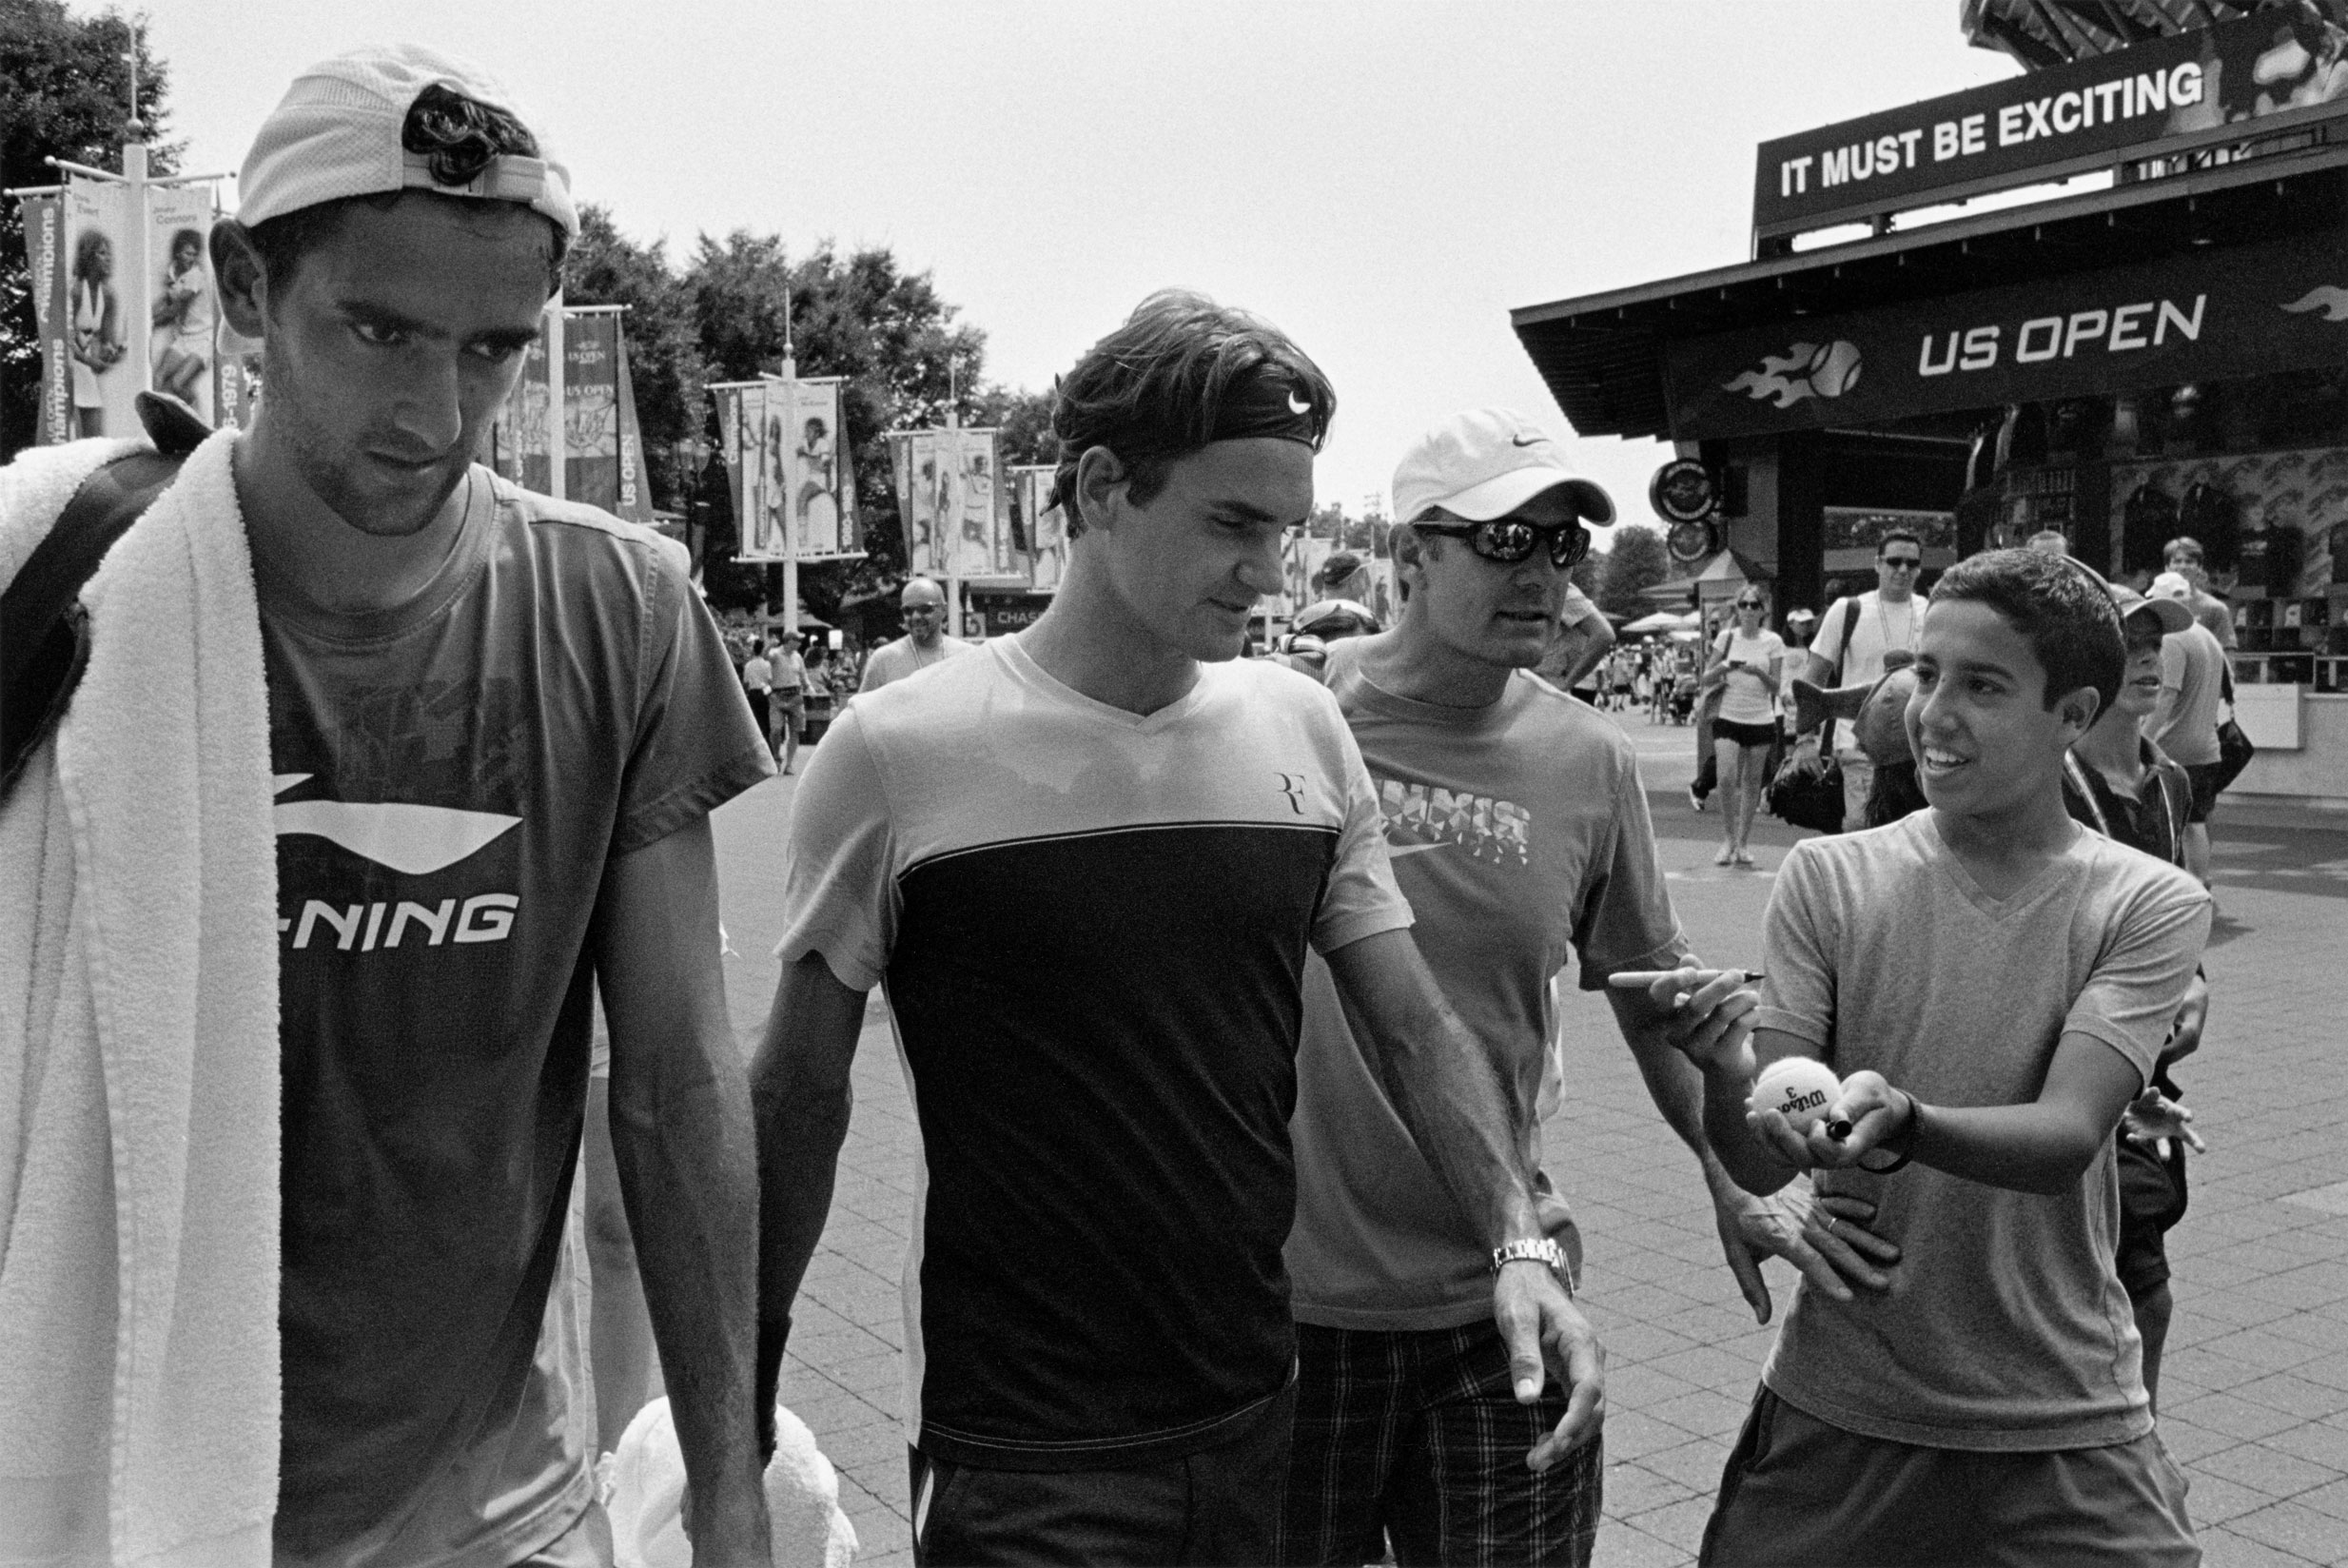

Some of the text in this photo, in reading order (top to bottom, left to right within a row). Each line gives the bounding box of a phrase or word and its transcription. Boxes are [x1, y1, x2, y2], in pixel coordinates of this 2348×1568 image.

[1781, 62, 2203, 197] IT MUST BE EXCITING
[1918, 294, 2207, 377] US OPEN
[621, 434, 636, 506] US OPEN
[1785, 1087, 1796, 1100] 3
